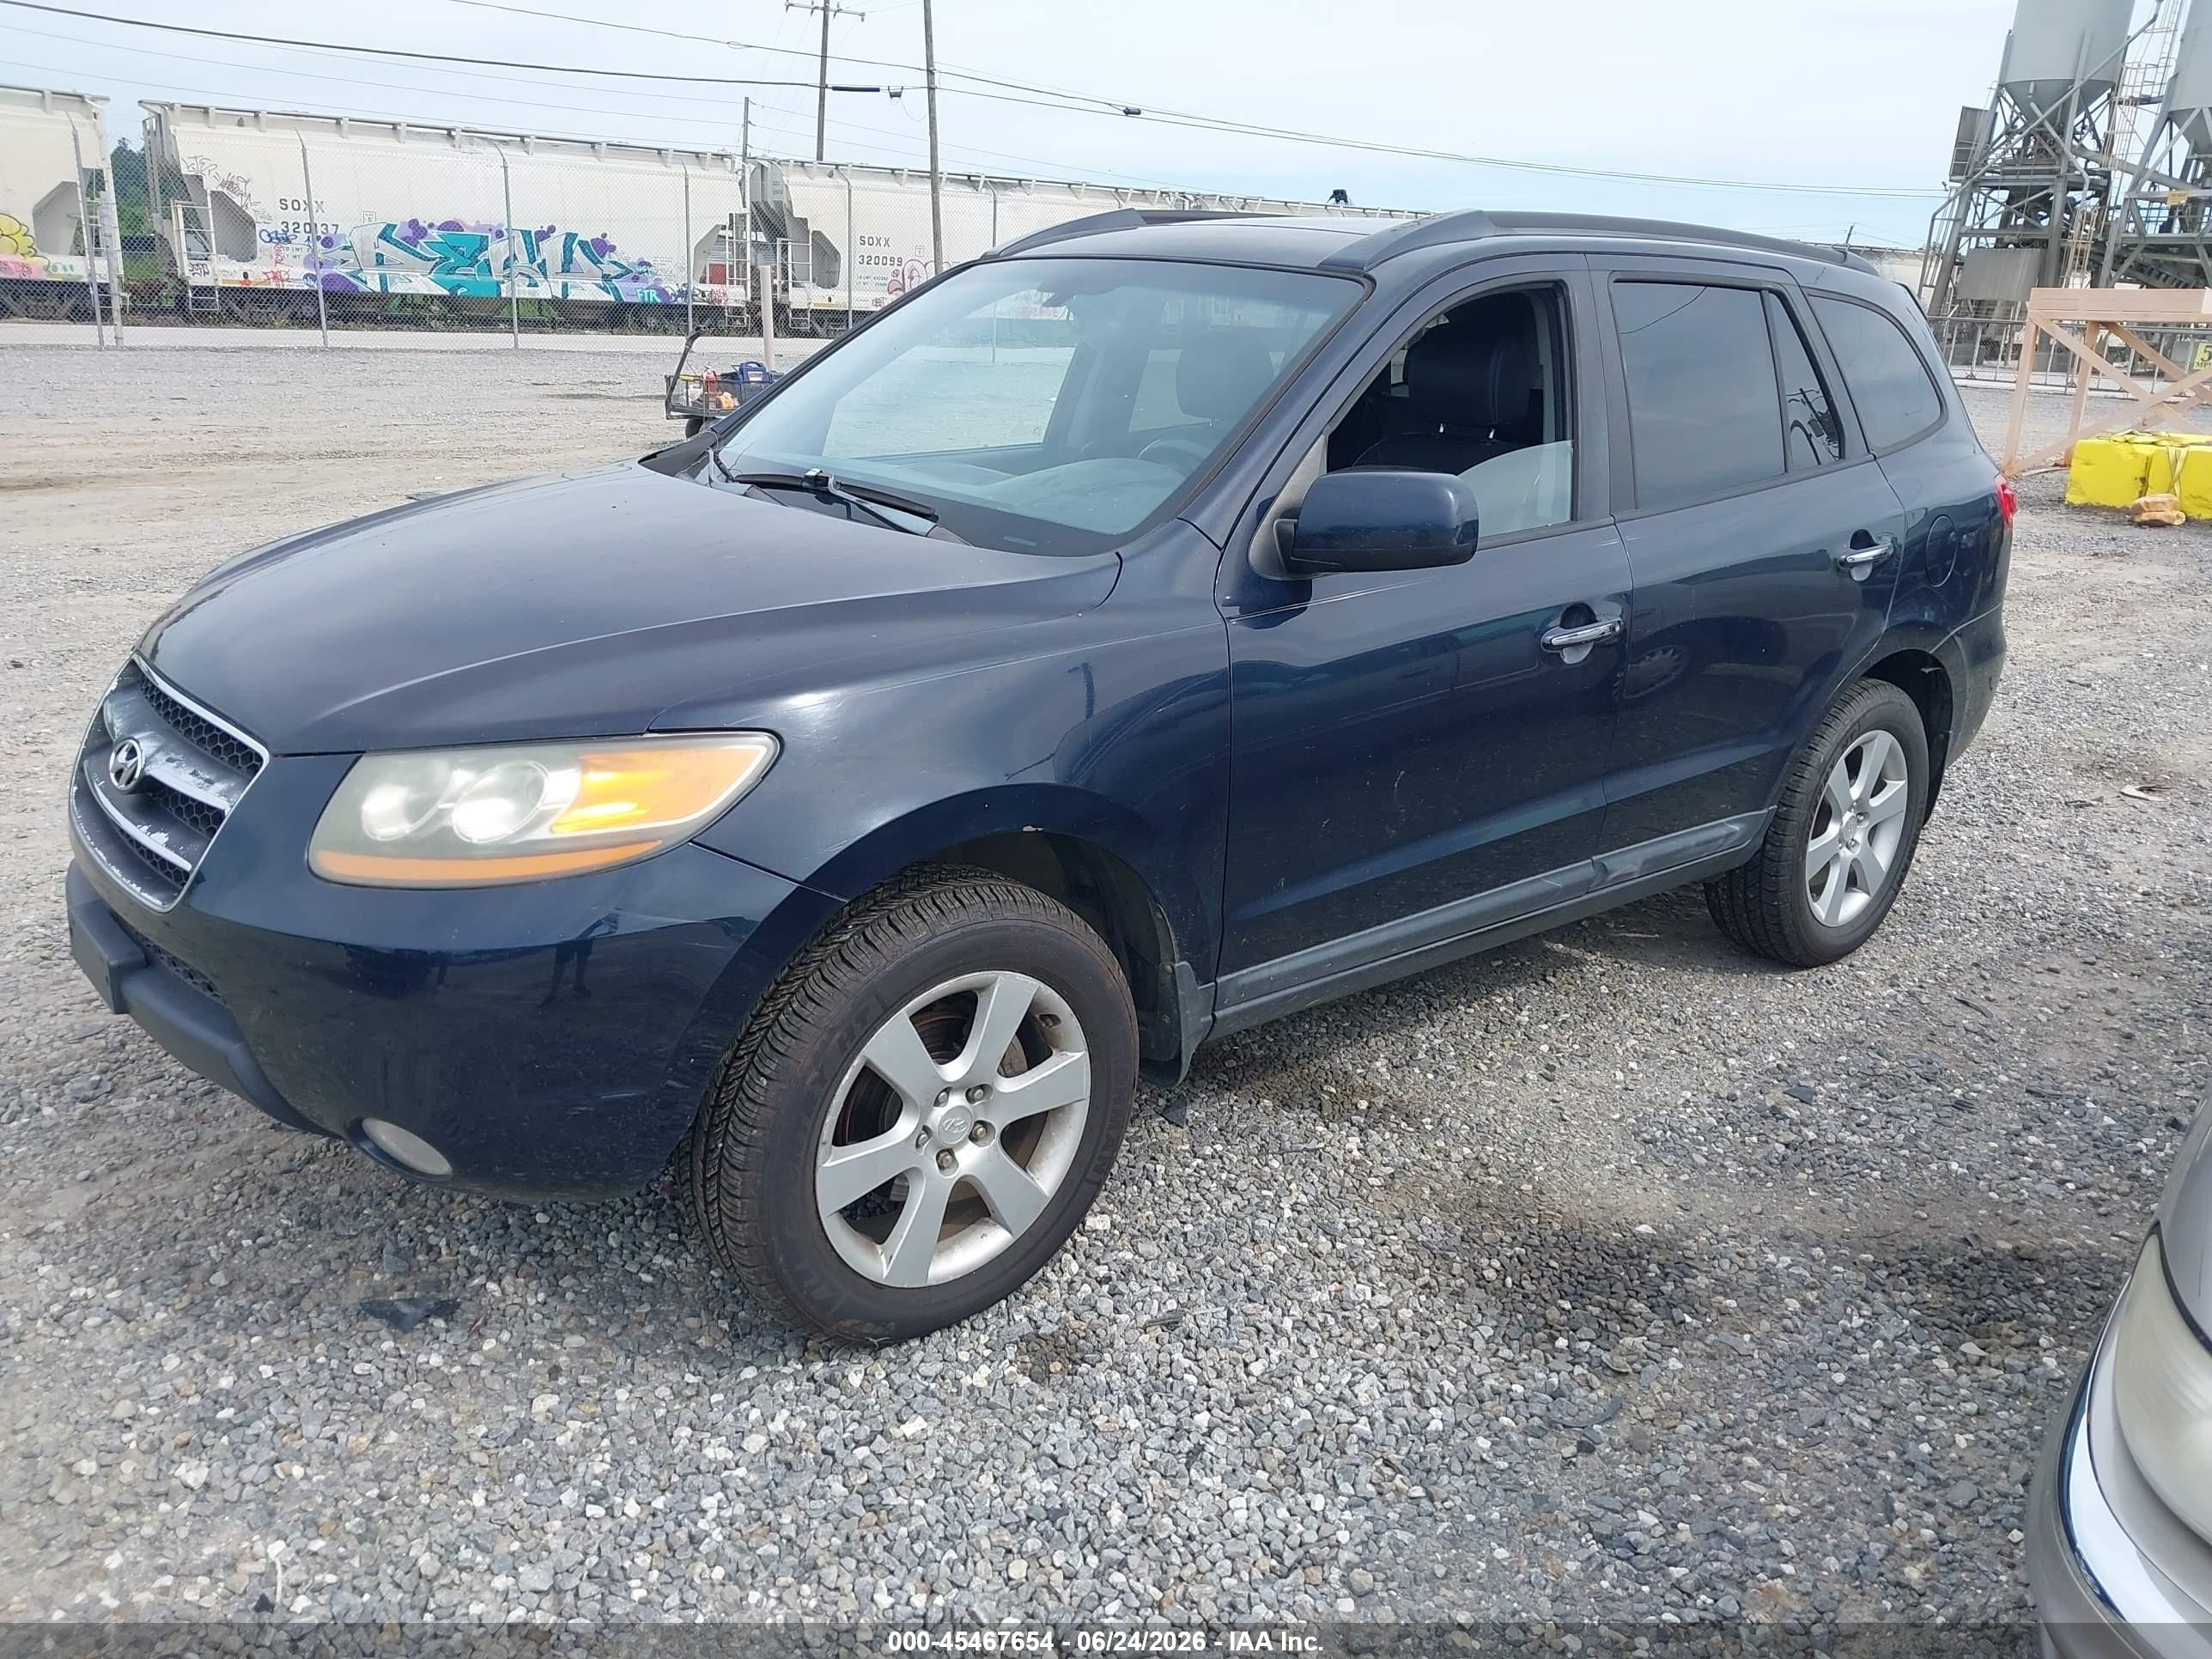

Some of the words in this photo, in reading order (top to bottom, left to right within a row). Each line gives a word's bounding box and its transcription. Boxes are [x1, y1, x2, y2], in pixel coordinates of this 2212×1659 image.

[279, 198, 325, 213] SOXX
[281, 221, 339, 234] 320137
[859, 235, 890, 247] SOXX
[859, 255, 902, 266] 320099
[635, 288, 662, 303] FTR
[2200, 345, 2212, 362] 5
